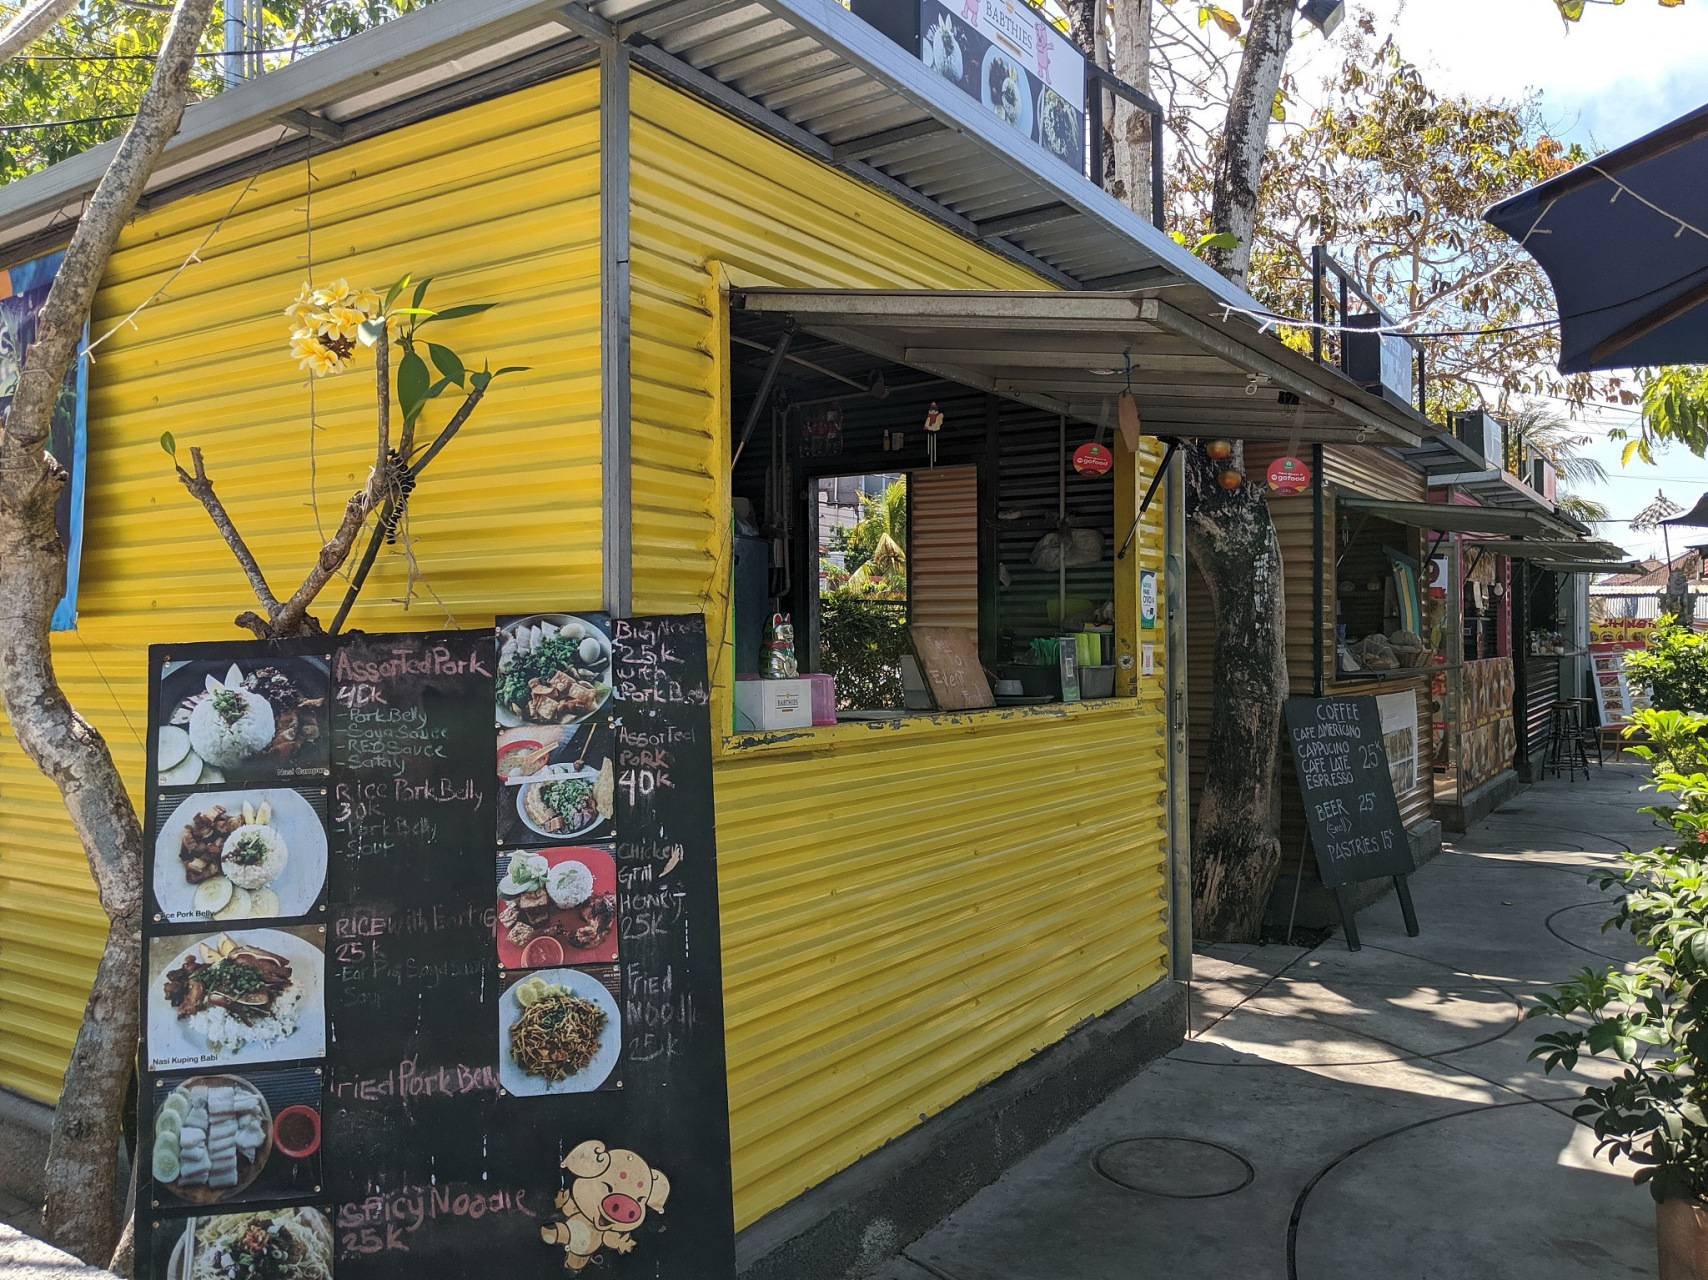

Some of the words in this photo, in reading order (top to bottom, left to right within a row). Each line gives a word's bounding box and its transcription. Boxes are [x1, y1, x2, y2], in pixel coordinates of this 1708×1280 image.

[986, 0, 1033, 50] BABTHIES
[616, 620, 655, 646] Big
[433, 646, 492, 678] Pork
[1316, 704, 1359, 720] COFFEE
[1293, 728, 1316, 741] CAFE
[1317, 723, 1361, 739] AMERICANO
[1297, 741, 1350, 758] CAPPUCINO
[347, 754, 406, 777] Satay
[1301, 759, 1326, 773] CAFE
[1329, 755, 1351, 772] LATE
[1305, 772, 1353, 789] ESPRESSO
[336, 779, 388, 801] Rice
[394, 778, 437, 801] Pork
[438, 778, 483, 812] Belly
[1314, 798, 1349, 822] BEER
[176, 910, 194, 918] Pork
[195, 909, 215, 918] Belly
[152, 1057, 170, 1065] Nasi
[171, 1056, 199, 1064] Kuping
[200, 1054, 218, 1062] Babi
[399, 1053, 453, 1097] Pork
